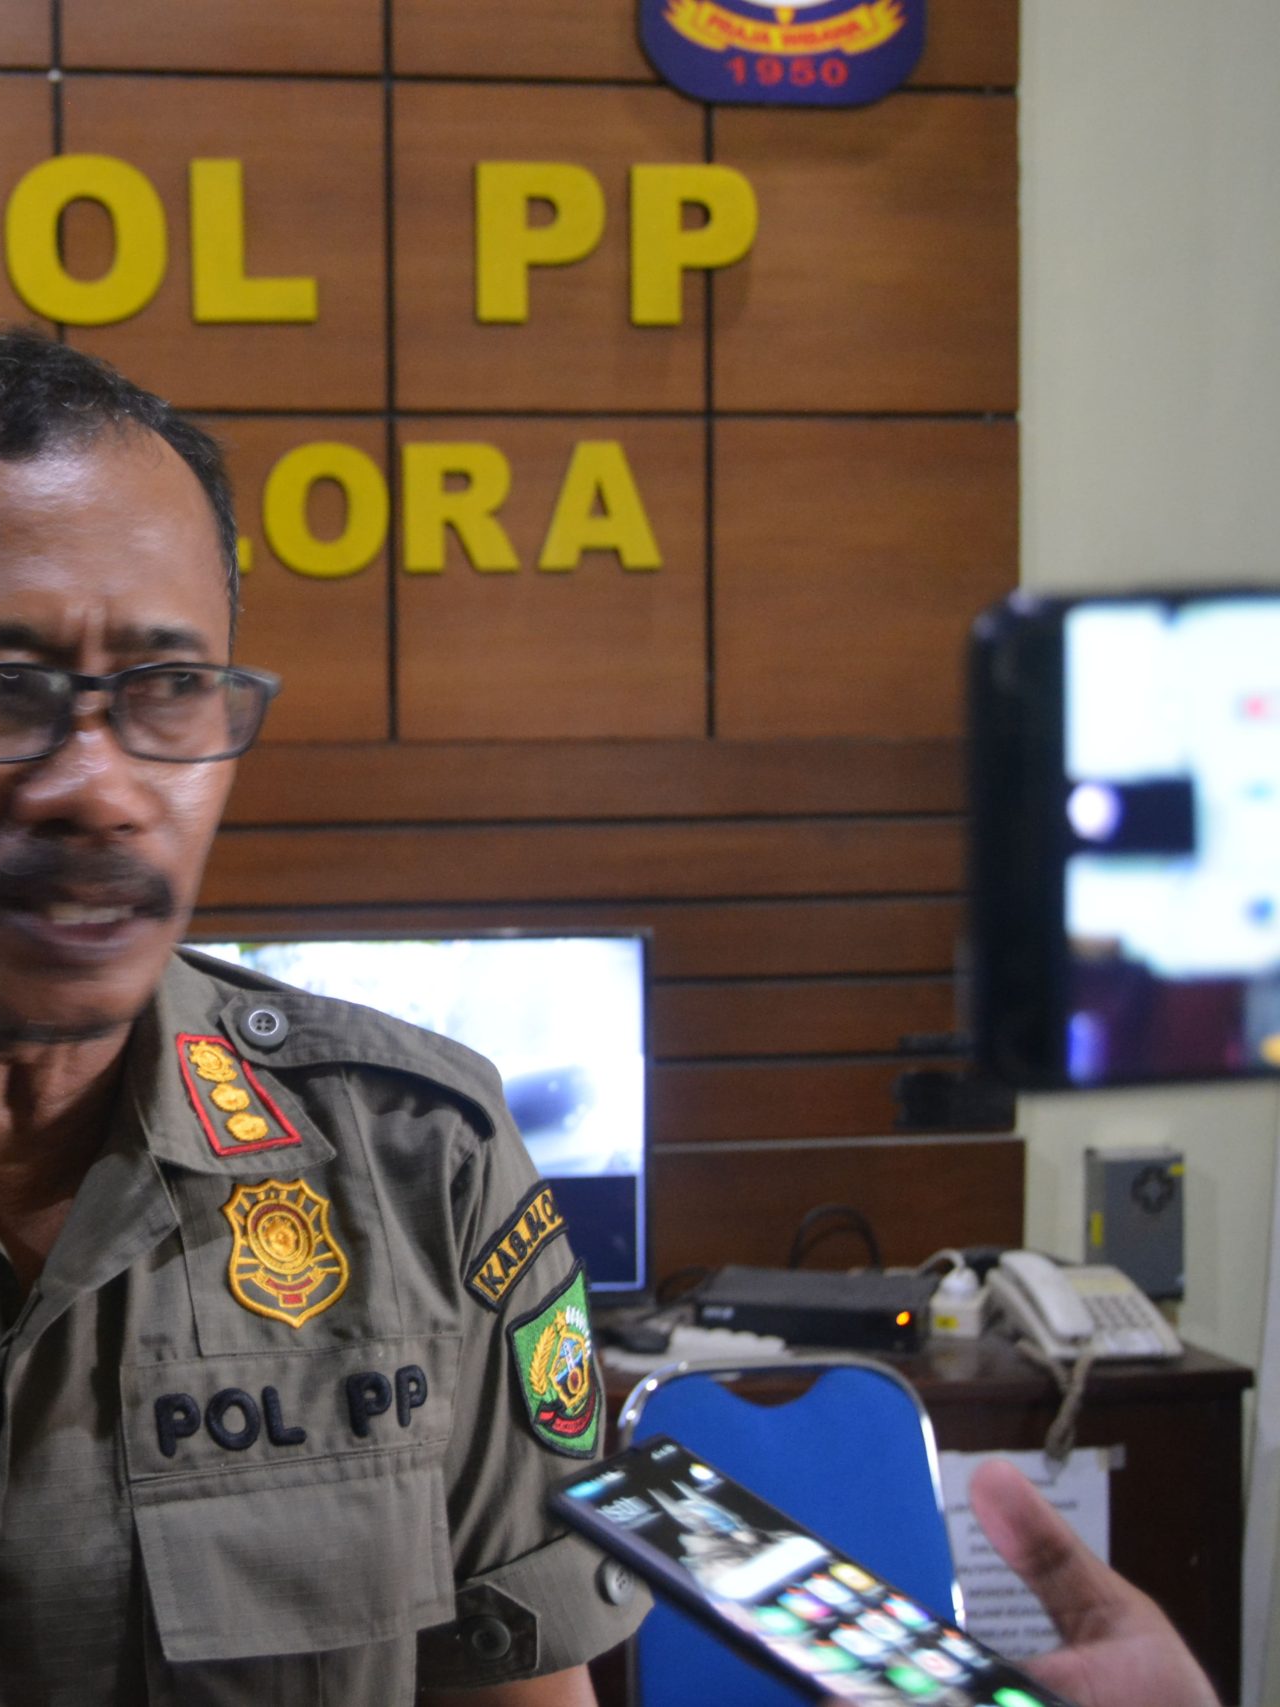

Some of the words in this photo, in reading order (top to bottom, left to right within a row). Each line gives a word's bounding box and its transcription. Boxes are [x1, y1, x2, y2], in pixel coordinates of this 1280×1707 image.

[725, 56, 849, 87] 1950
[475, 160, 760, 326] PP
[154, 1385, 308, 1459] POL
[346, 1364, 429, 1439] PP
